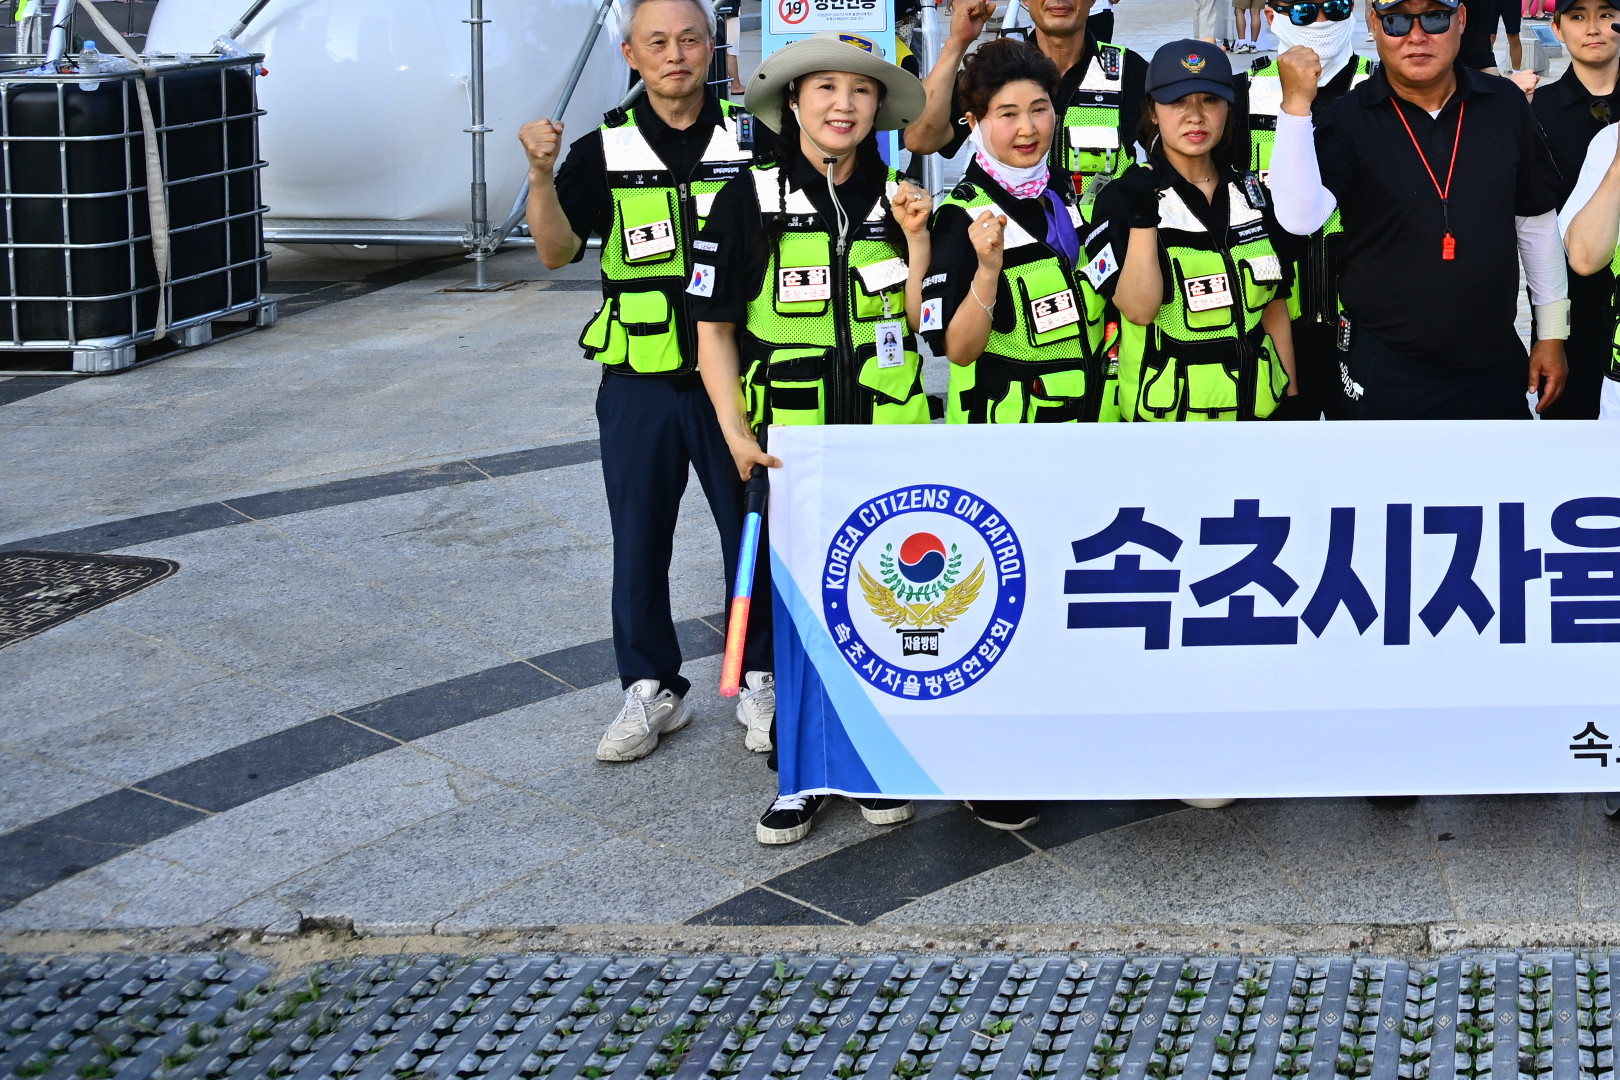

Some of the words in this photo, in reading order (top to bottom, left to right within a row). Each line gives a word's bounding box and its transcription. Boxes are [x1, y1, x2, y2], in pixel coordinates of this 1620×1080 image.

[785, 1, 802, 15] 19
[630, 222, 669, 245] 순찰
[783, 269, 826, 287] 순찰
[1189, 276, 1226, 297] 순찰
[1035, 293, 1073, 318] 순찰
[825, 525, 865, 590] KOREA
[858, 487, 950, 528] CITIZENS
[954, 495, 985, 522] ON
[979, 513, 1022, 587] PATROL
[903, 635, 939, 651] 자율방범
[834, 617, 1014, 697] 속초시자율방범연합회
